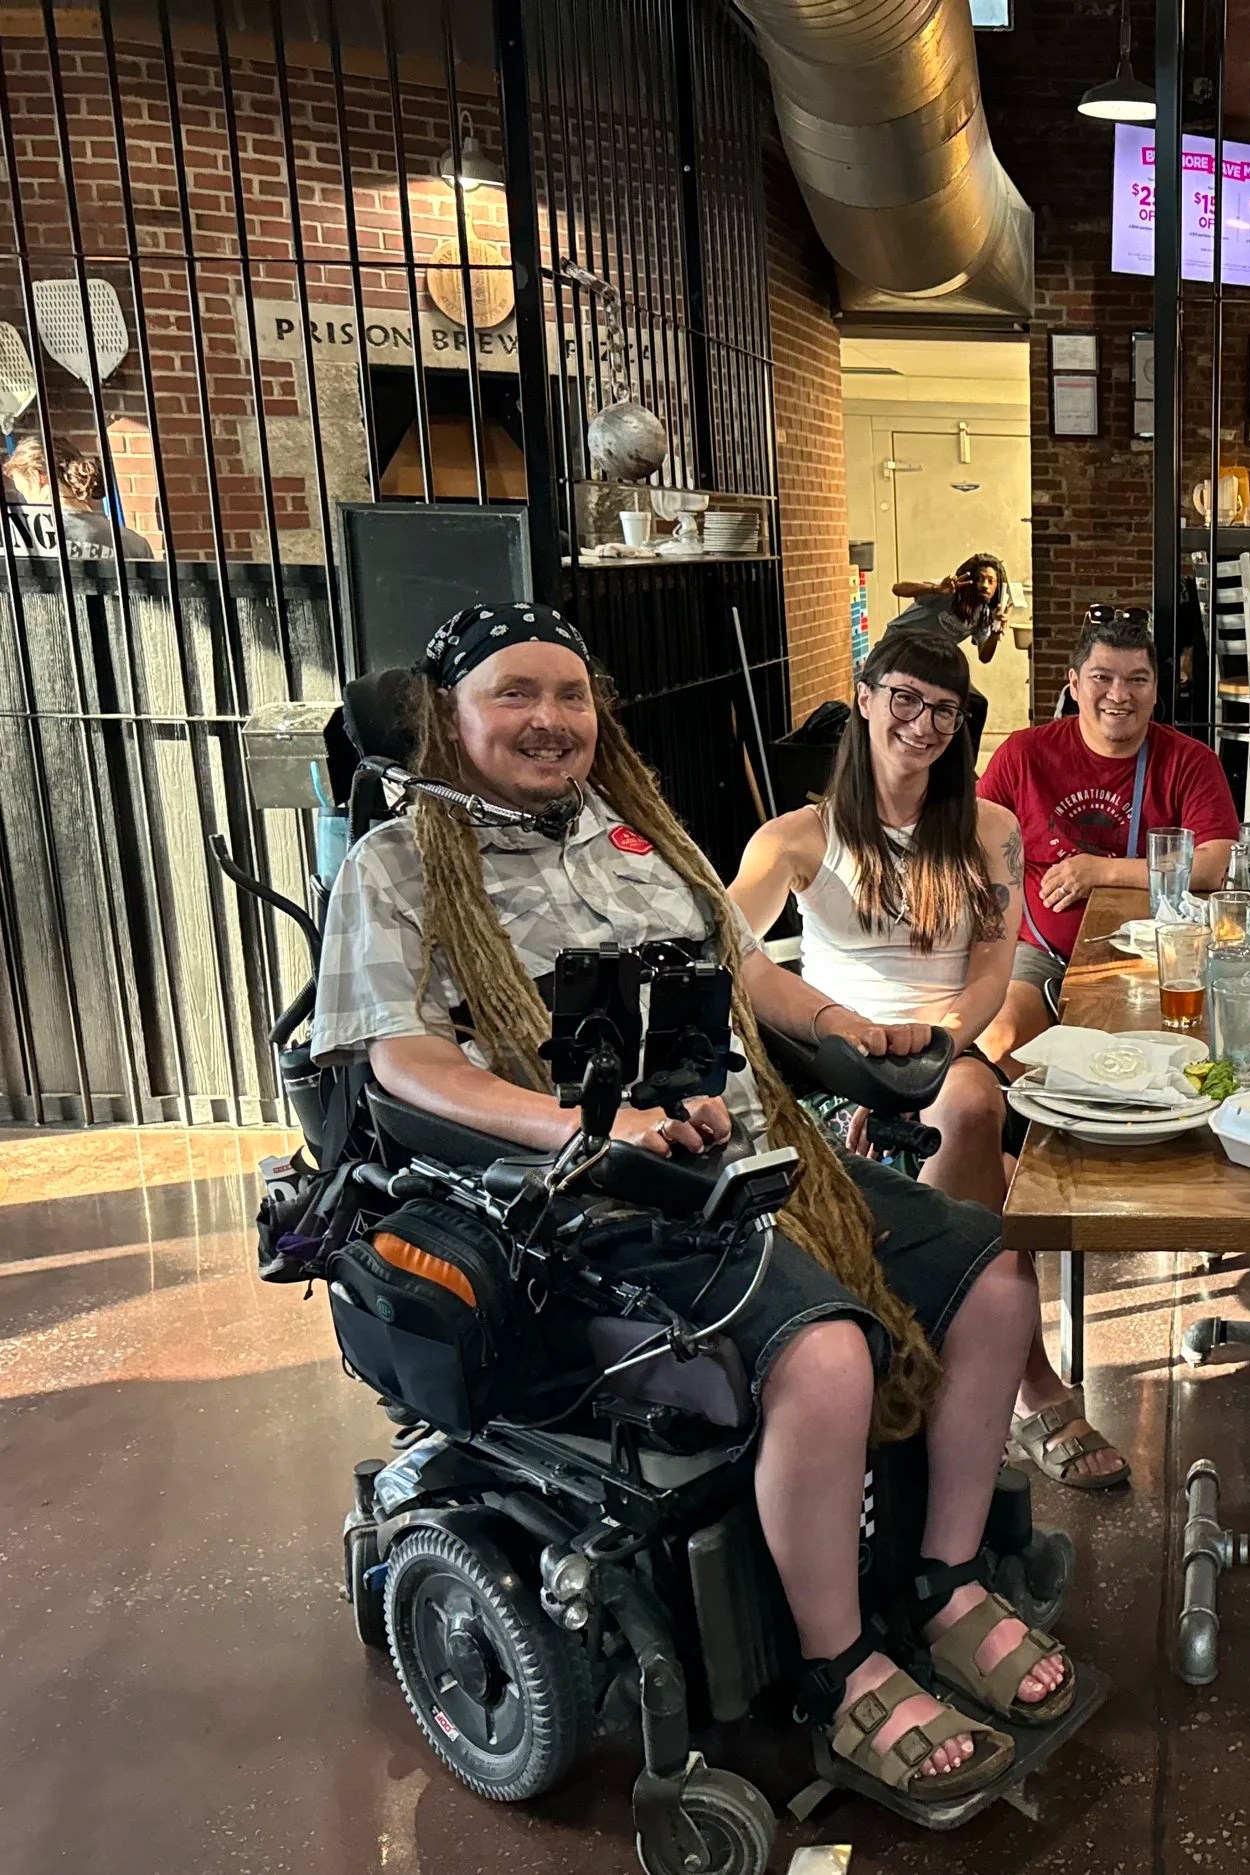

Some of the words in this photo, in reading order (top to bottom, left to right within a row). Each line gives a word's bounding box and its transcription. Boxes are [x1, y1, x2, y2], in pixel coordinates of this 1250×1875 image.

[1182, 155, 1209, 169] ORE
[1131, 183, 1155, 207] $2
[1139, 208, 1155, 222] OF
[1198, 217, 1215, 230] OF
[275, 318, 415, 349] PRISON
[432, 329, 519, 355] BREW
[565, 339, 651, 364] PIZ
[0, 512, 57, 550] NG
[1054, 788, 1121, 817] INTERNATIONAL
